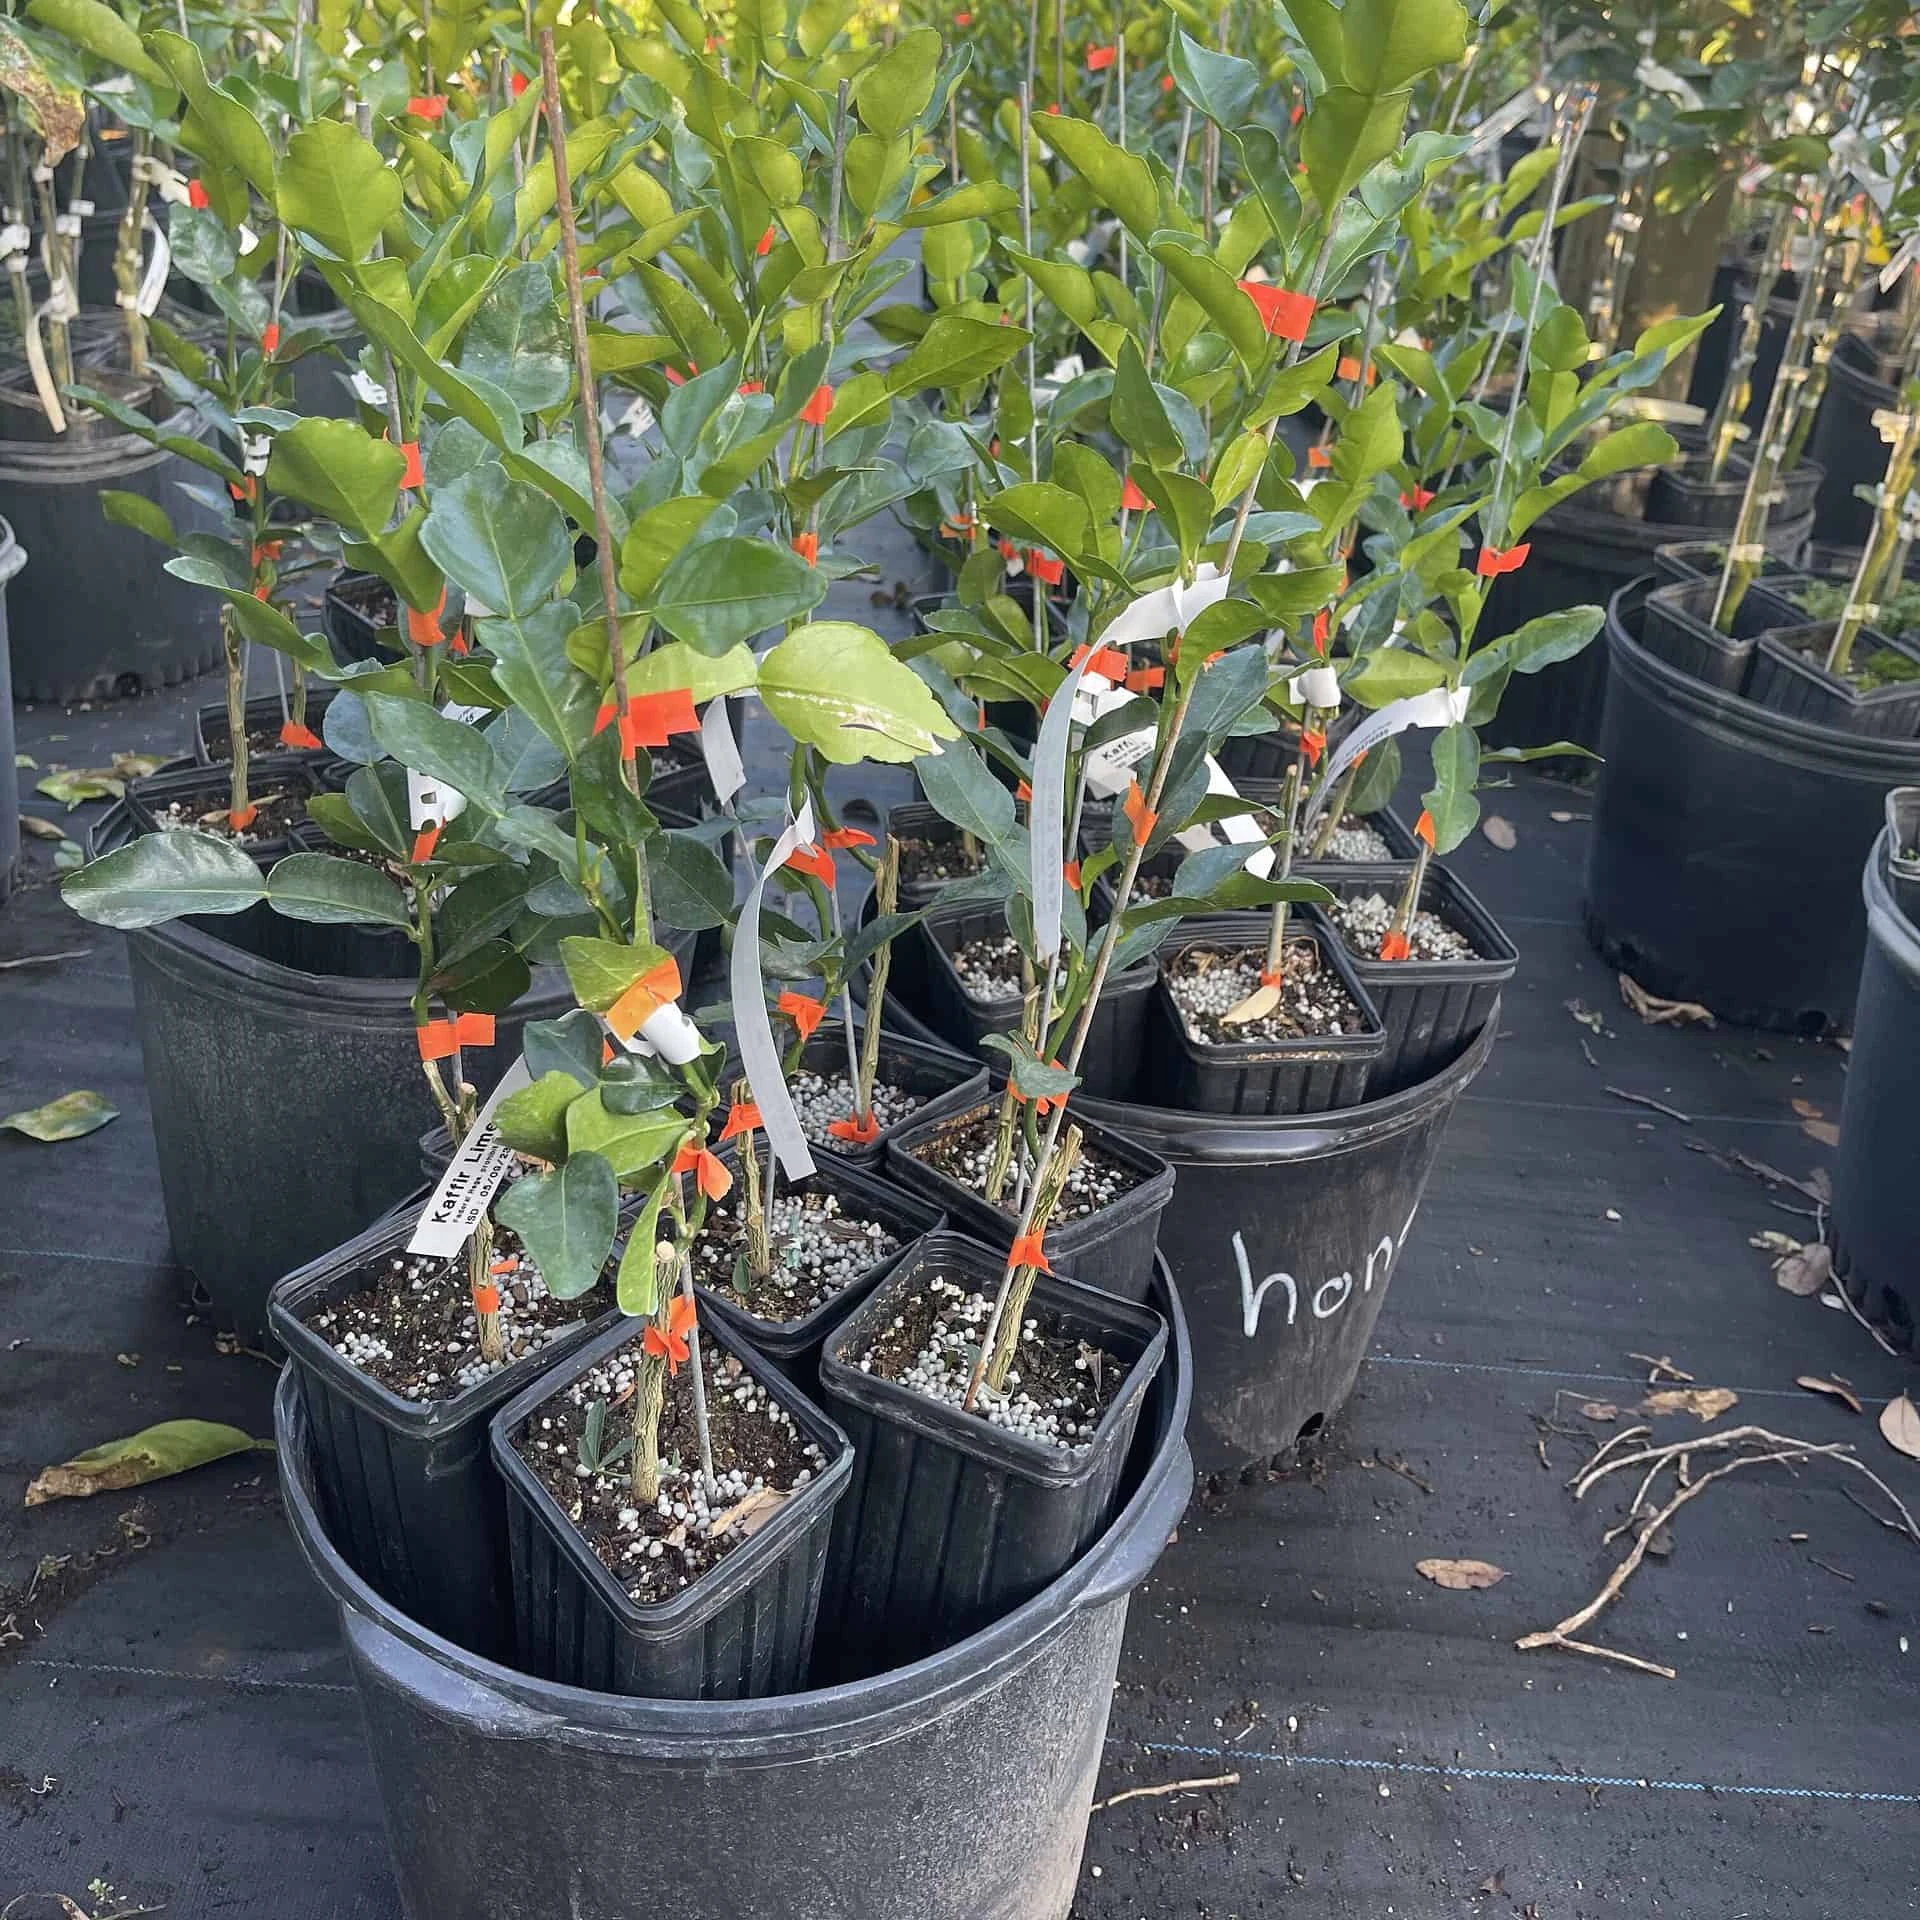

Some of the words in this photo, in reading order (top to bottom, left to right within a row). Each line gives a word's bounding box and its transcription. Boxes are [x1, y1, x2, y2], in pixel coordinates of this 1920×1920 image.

[431, 1171, 470, 1223] Kaffir
[464, 1122, 496, 1163] Lime
[1231, 1197, 1421, 1338] hon
